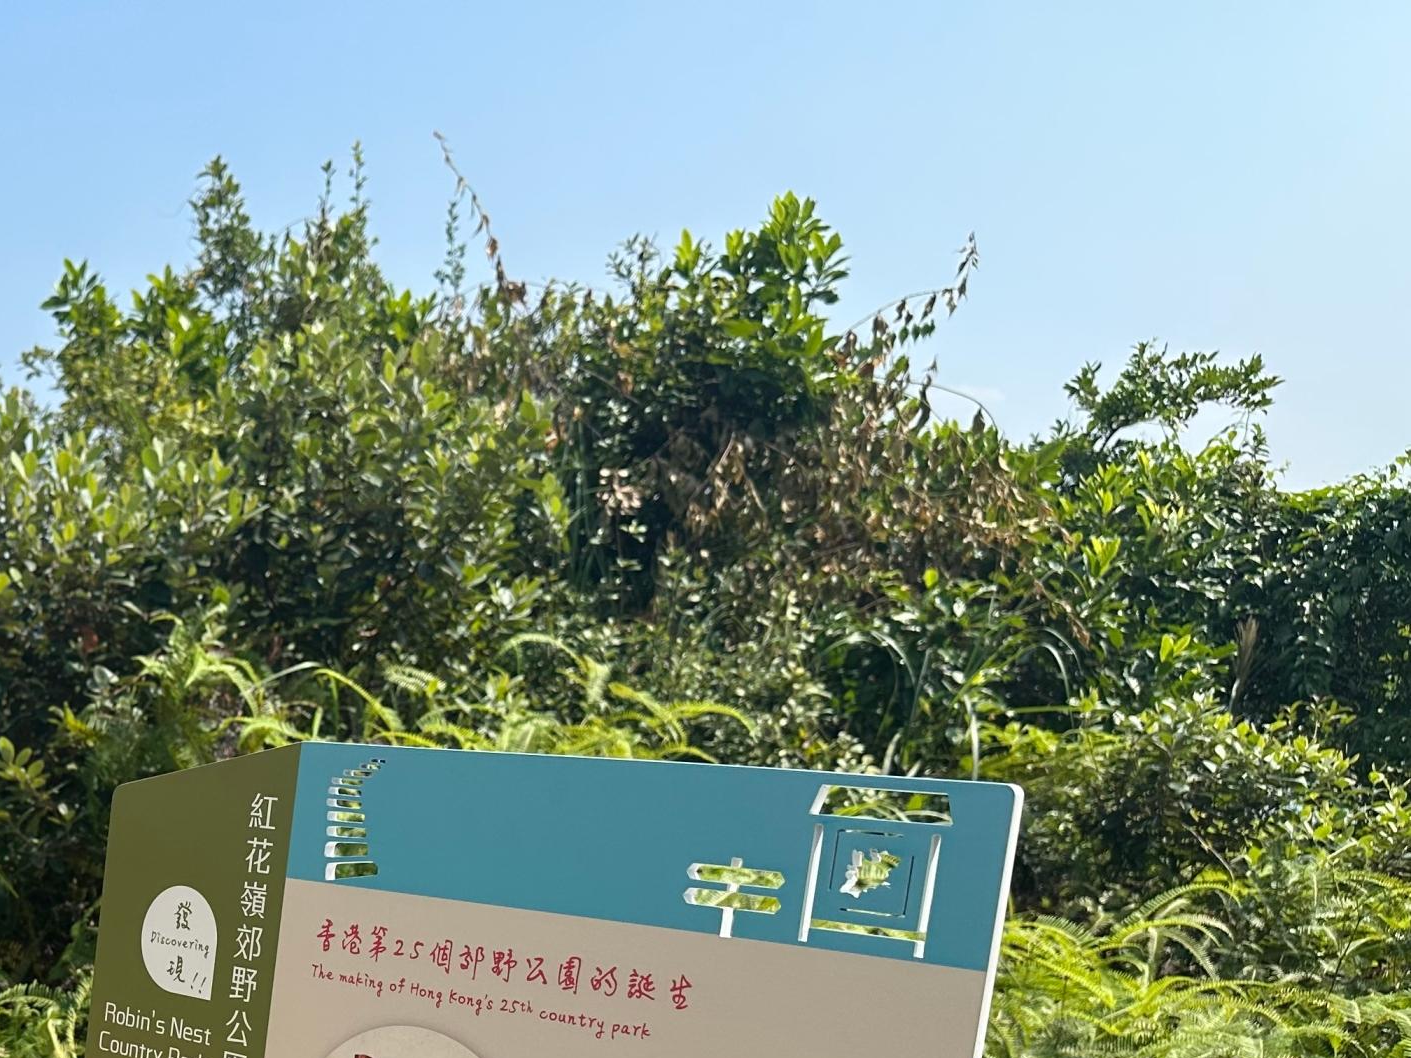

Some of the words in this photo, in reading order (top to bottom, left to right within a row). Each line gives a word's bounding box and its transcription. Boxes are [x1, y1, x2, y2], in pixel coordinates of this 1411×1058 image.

[150, 931, 210, 959] Discovering
[317, 919, 692, 1009] 香港第25個郊野公園的誕生
[104, 1002, 165, 1035] Robin's
[170, 1016, 212, 1046] Nest
[312, 963, 334, 981] The
[339, 972, 383, 997] making
[389, 978, 406, 994] of
[410, 983, 443, 1008] Hong
[500, 999, 533, 1014] 25th
[539, 1010, 605, 1039] country
[612, 1022, 651, 1039] park
